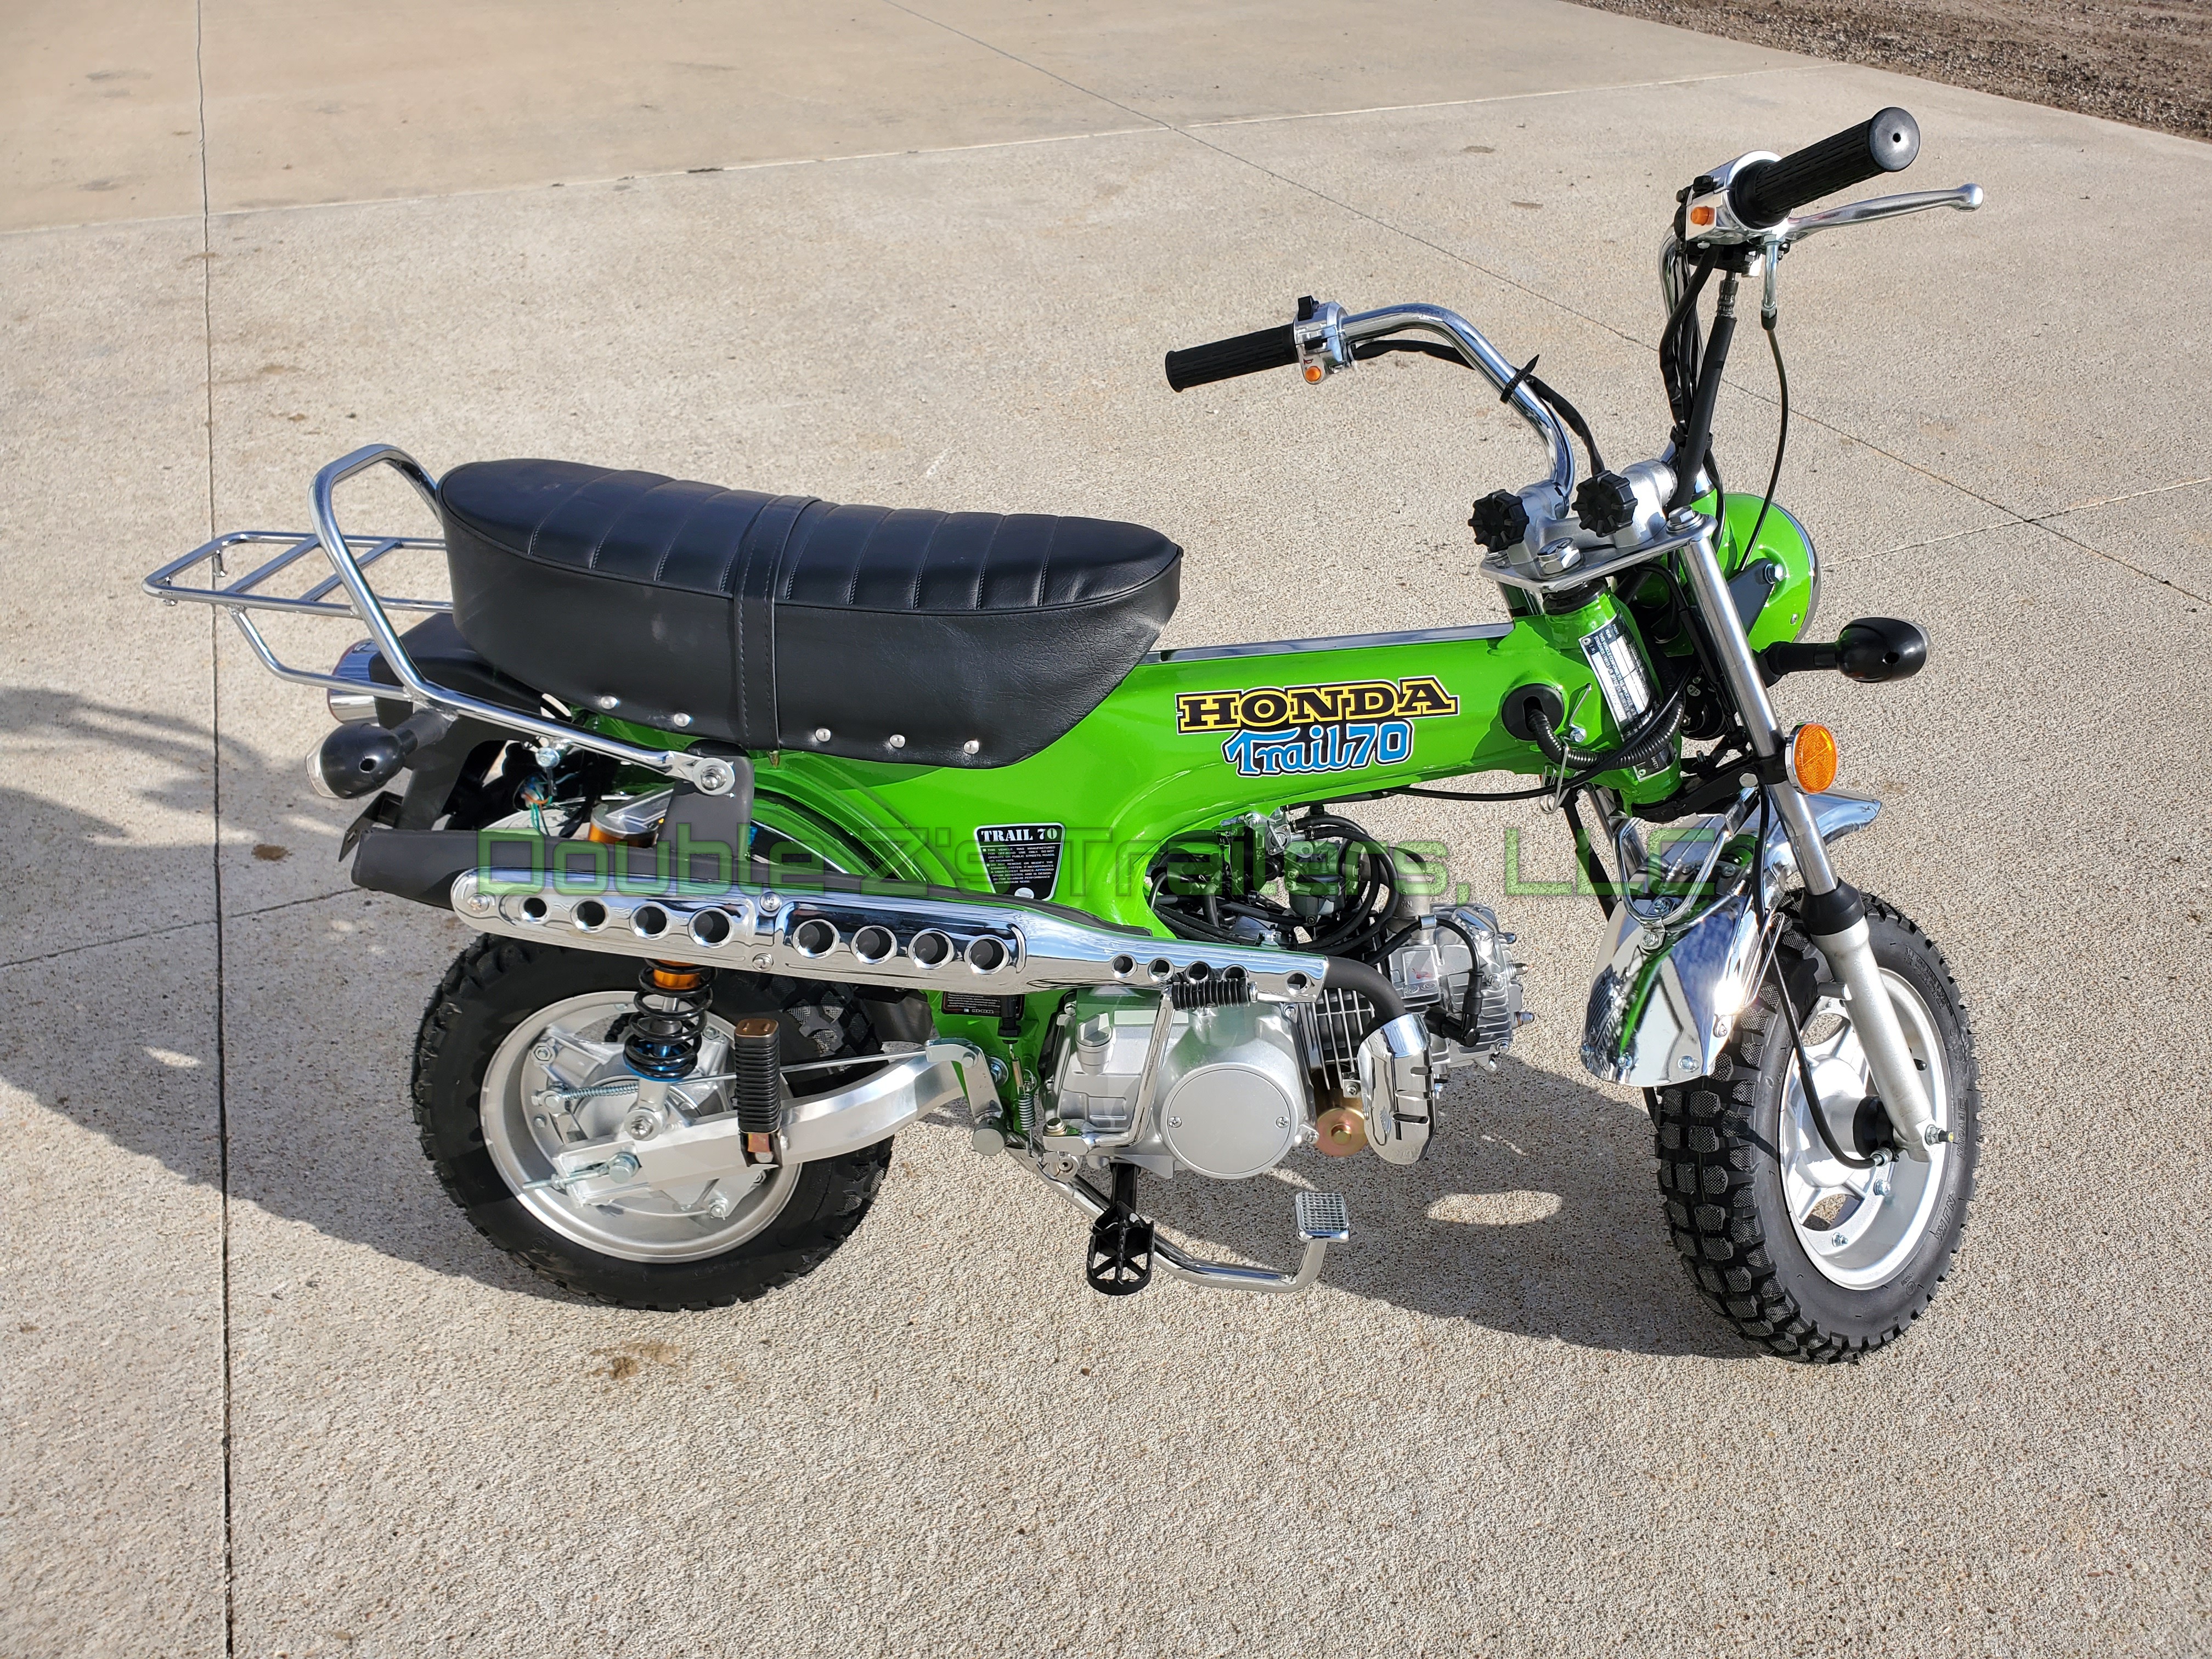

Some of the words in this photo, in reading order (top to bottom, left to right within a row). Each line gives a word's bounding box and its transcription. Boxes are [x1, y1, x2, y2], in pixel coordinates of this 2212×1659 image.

[1176, 676, 1459, 733] HONDA
[1650, 757, 1660, 769] SAFETY
[981, 829, 1033, 842] TRAIL
[1037, 828, 1057, 840] 70
